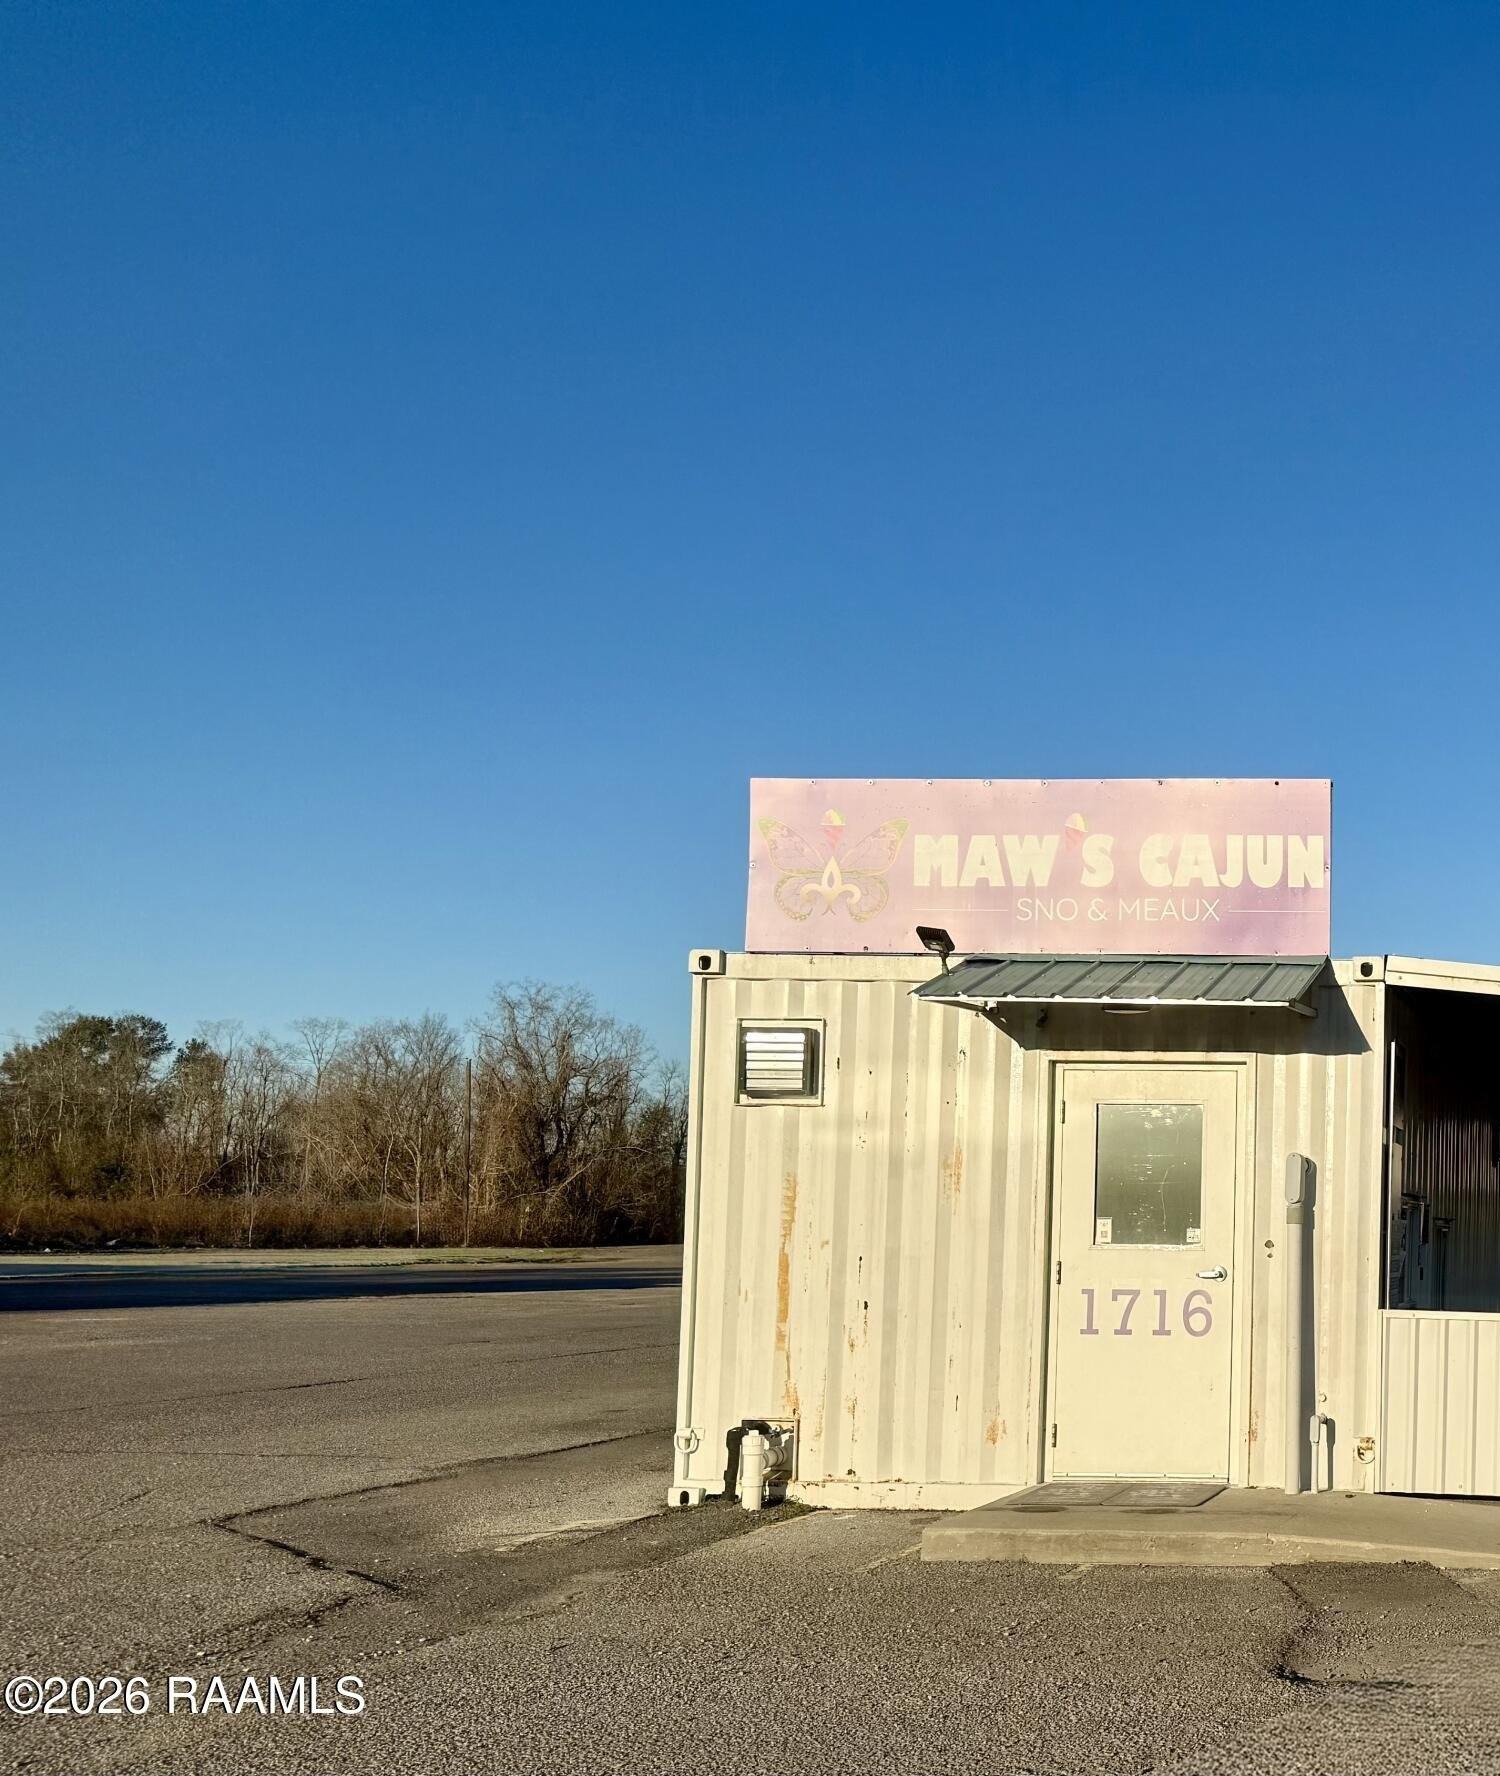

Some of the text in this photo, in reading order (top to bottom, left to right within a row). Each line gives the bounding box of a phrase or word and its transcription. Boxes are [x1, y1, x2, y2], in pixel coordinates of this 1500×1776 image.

[1138, 833, 1324, 888] CAJUN
[1016, 898, 1221, 922] SNO & MEAUX
[1079, 1287, 1213, 1338] 1716
